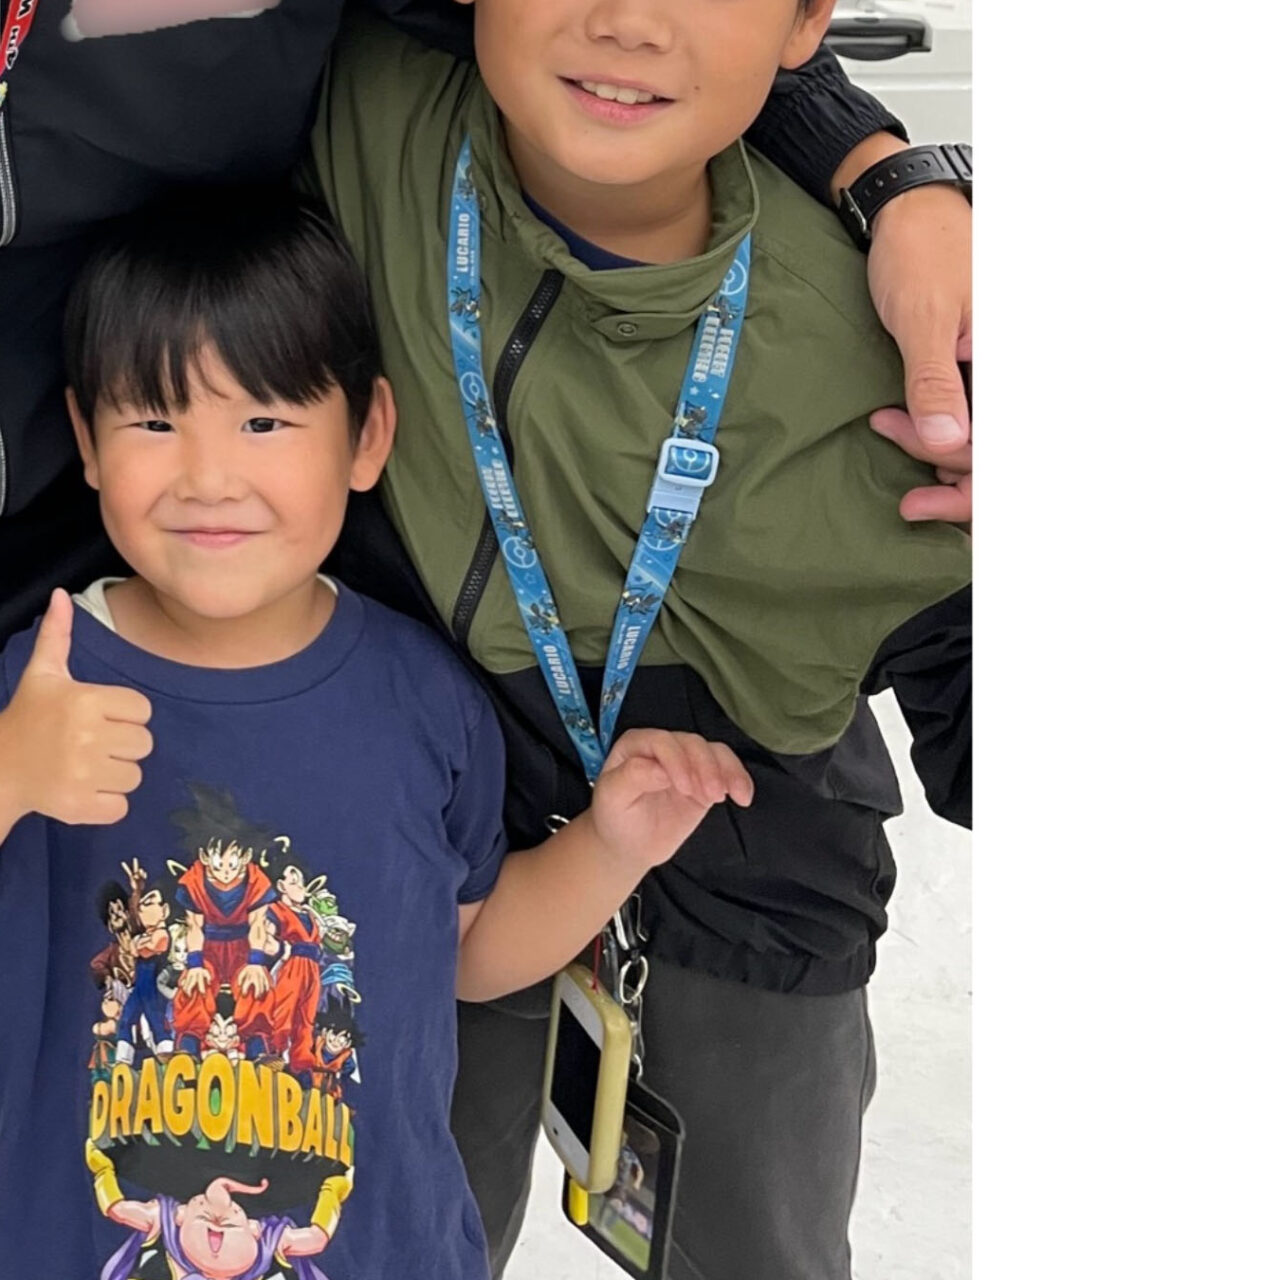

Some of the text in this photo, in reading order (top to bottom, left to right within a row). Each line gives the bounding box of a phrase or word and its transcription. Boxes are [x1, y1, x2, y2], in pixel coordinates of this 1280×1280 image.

[456, 213, 470, 272] LUCARIO
[543, 645, 571, 694] LUCARIO
[91, 1053, 351, 1167] DRAGONBALL
